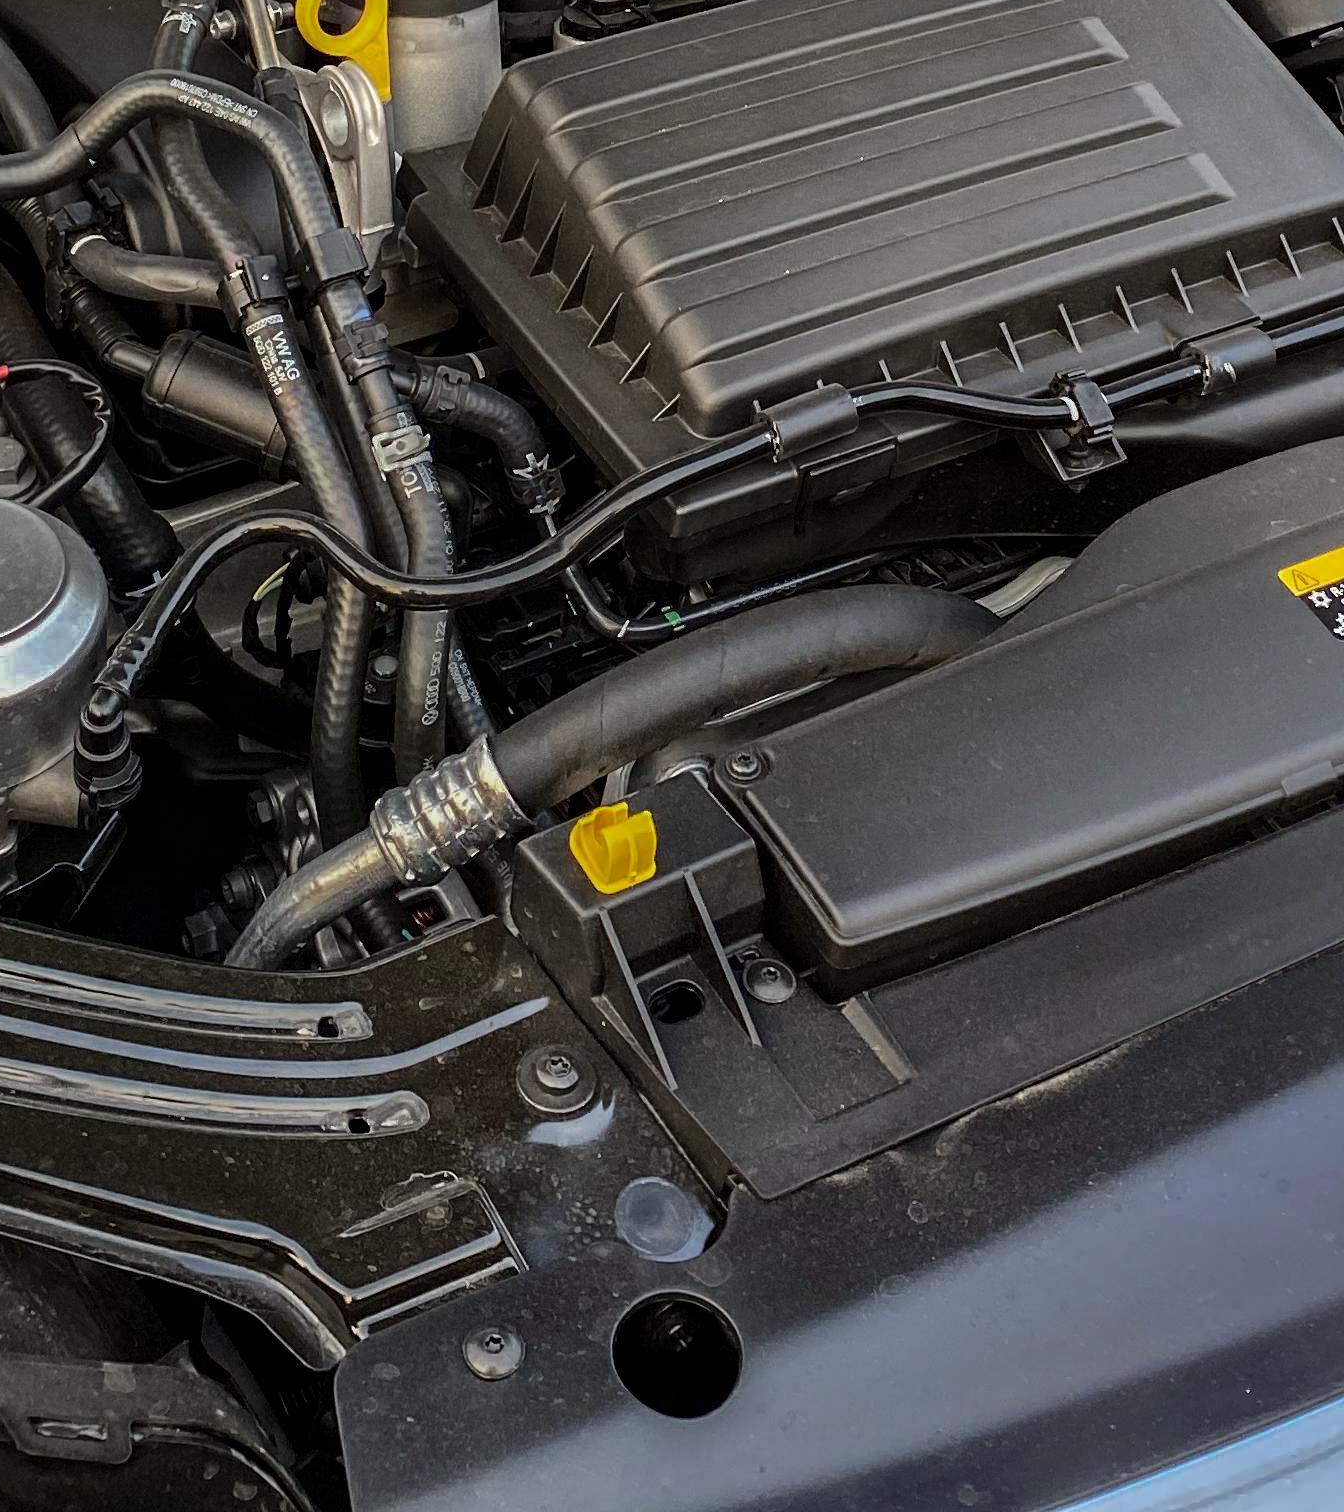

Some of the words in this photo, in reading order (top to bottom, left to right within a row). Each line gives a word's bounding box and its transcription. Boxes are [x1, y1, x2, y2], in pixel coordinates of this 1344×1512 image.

[264, 338, 279, 365] China
[272, 330, 292, 356] VW
[260, 355, 272, 372] 122
[267, 371, 280, 387] 101
[281, 359, 301, 381] AG
